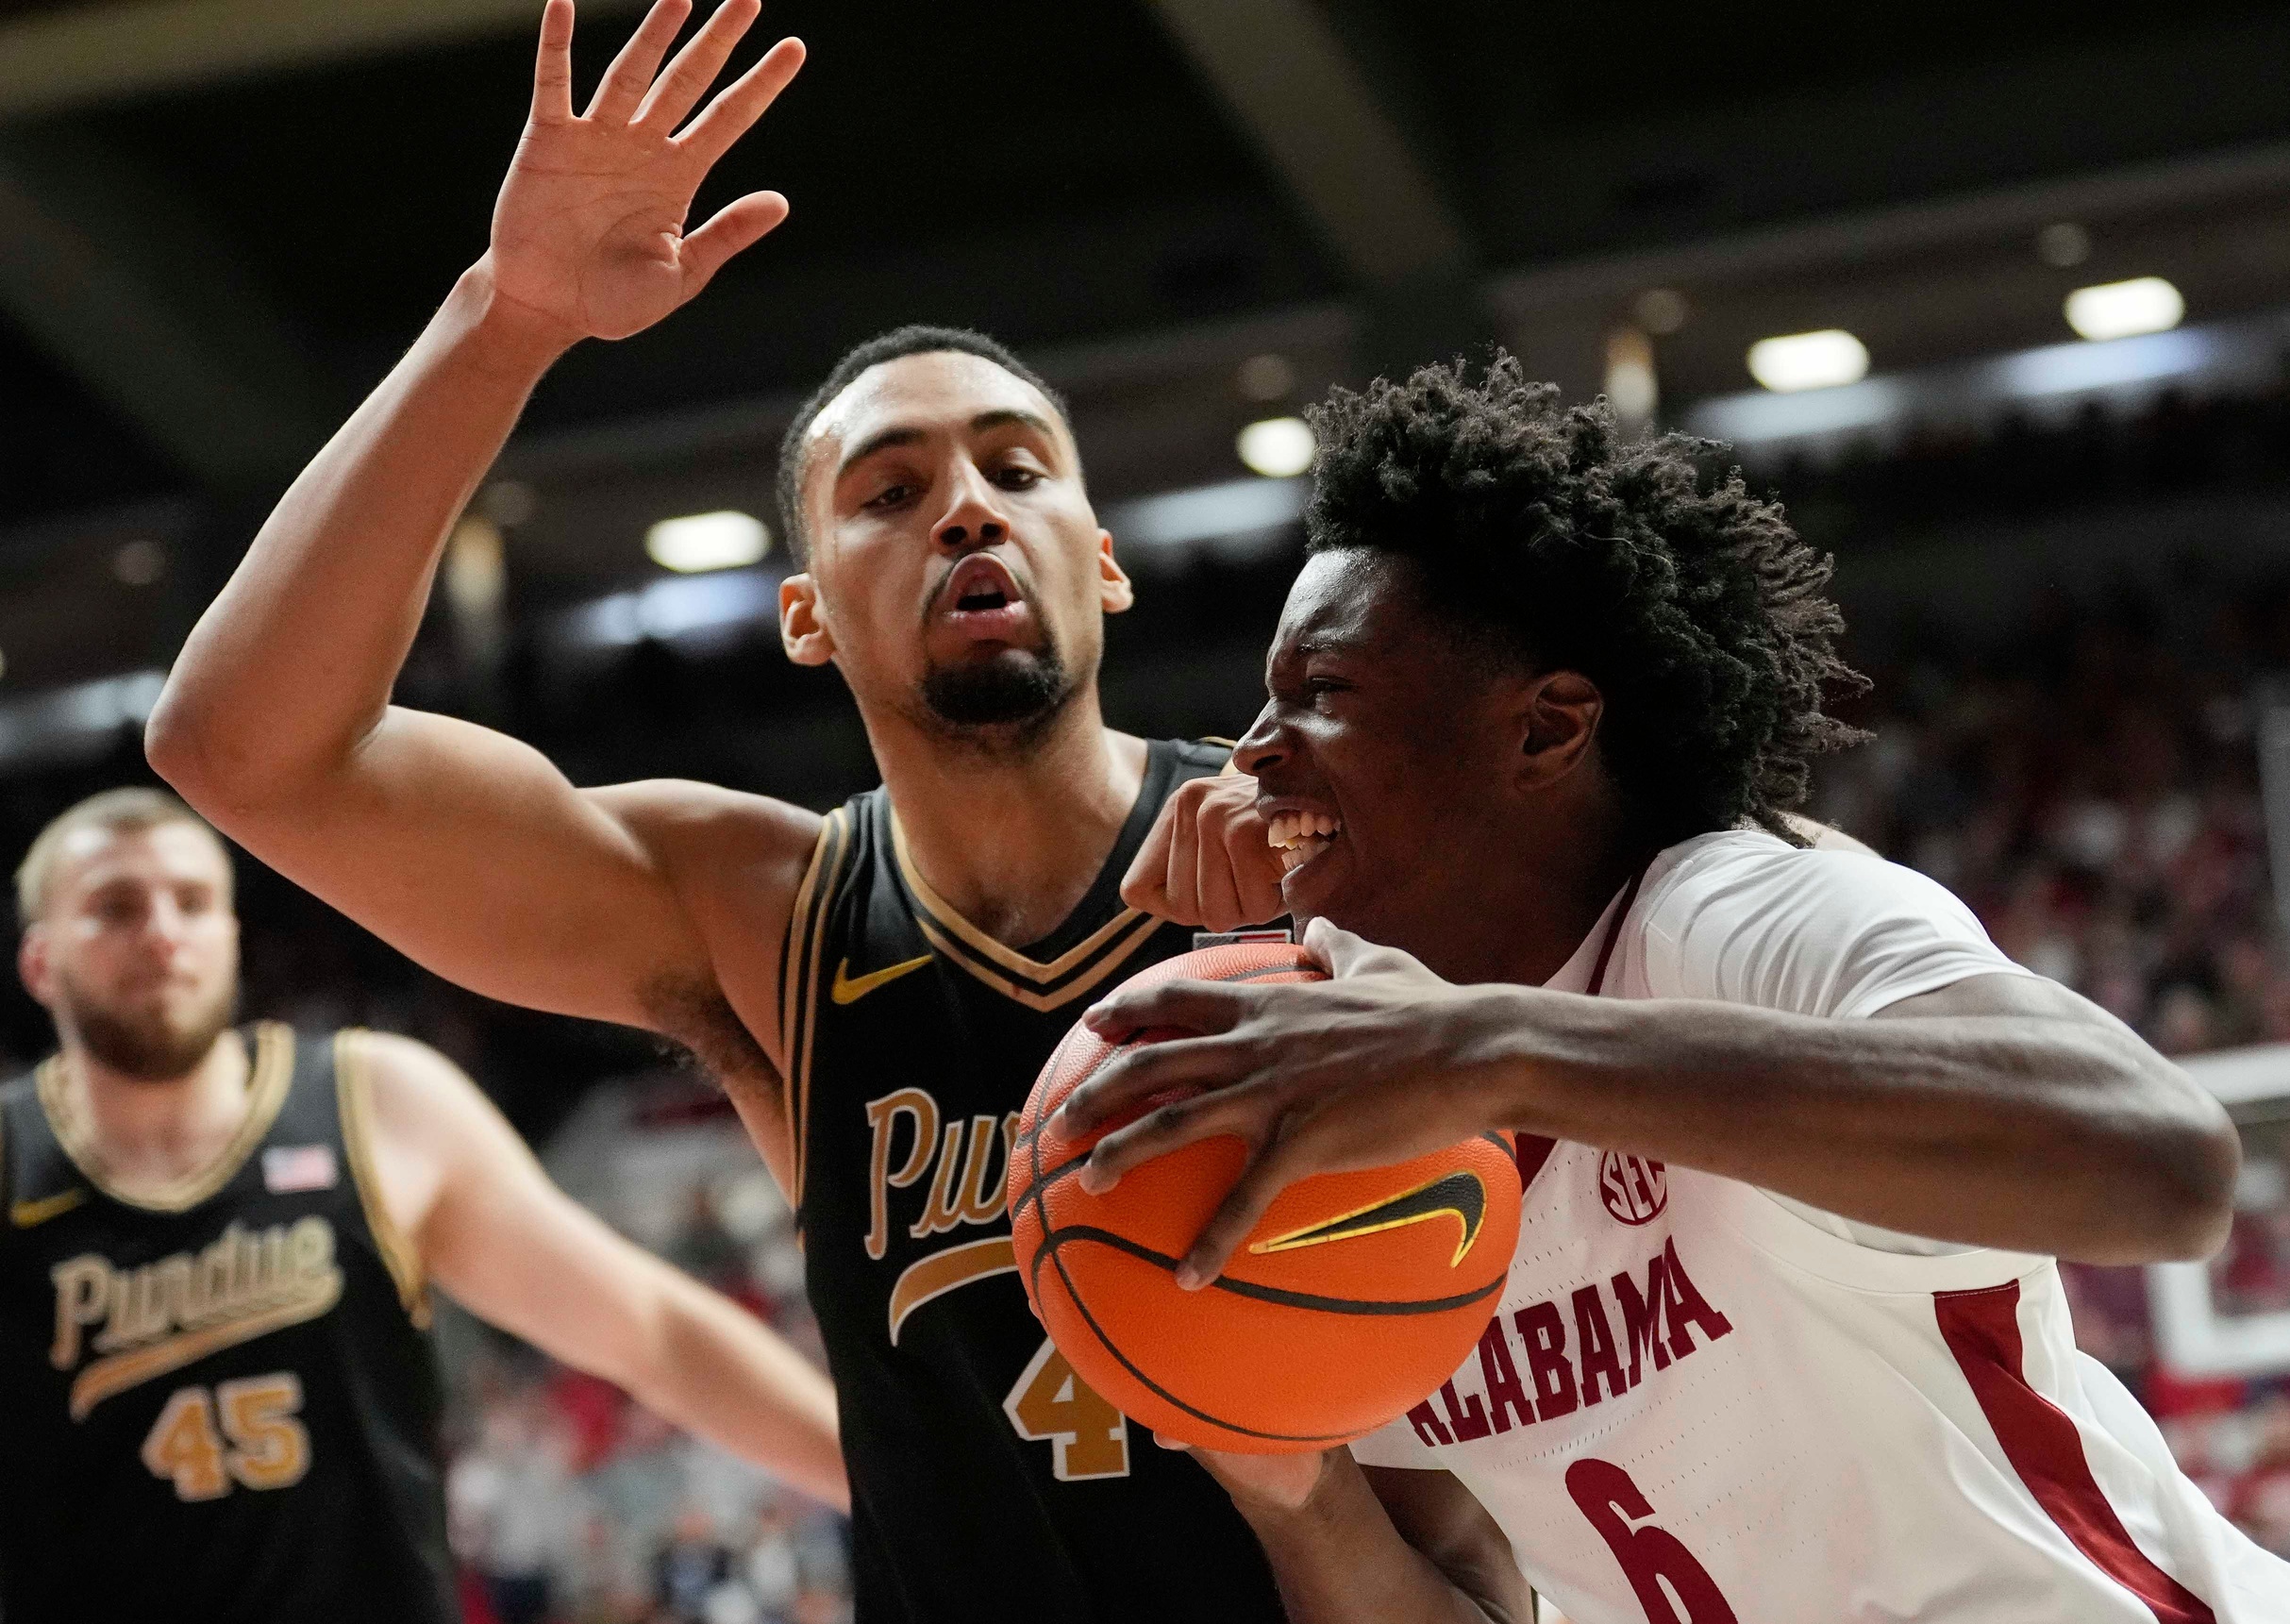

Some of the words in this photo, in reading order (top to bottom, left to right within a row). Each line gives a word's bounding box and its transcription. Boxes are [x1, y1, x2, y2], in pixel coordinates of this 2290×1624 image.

[1602, 1150, 1665, 1221] SEC
[49, 1215, 342, 1370] Purdue
[142, 1373, 311, 1501] 45
[1002, 1335, 1130, 1482] 4
[1565, 1458, 1738, 1624] 6
